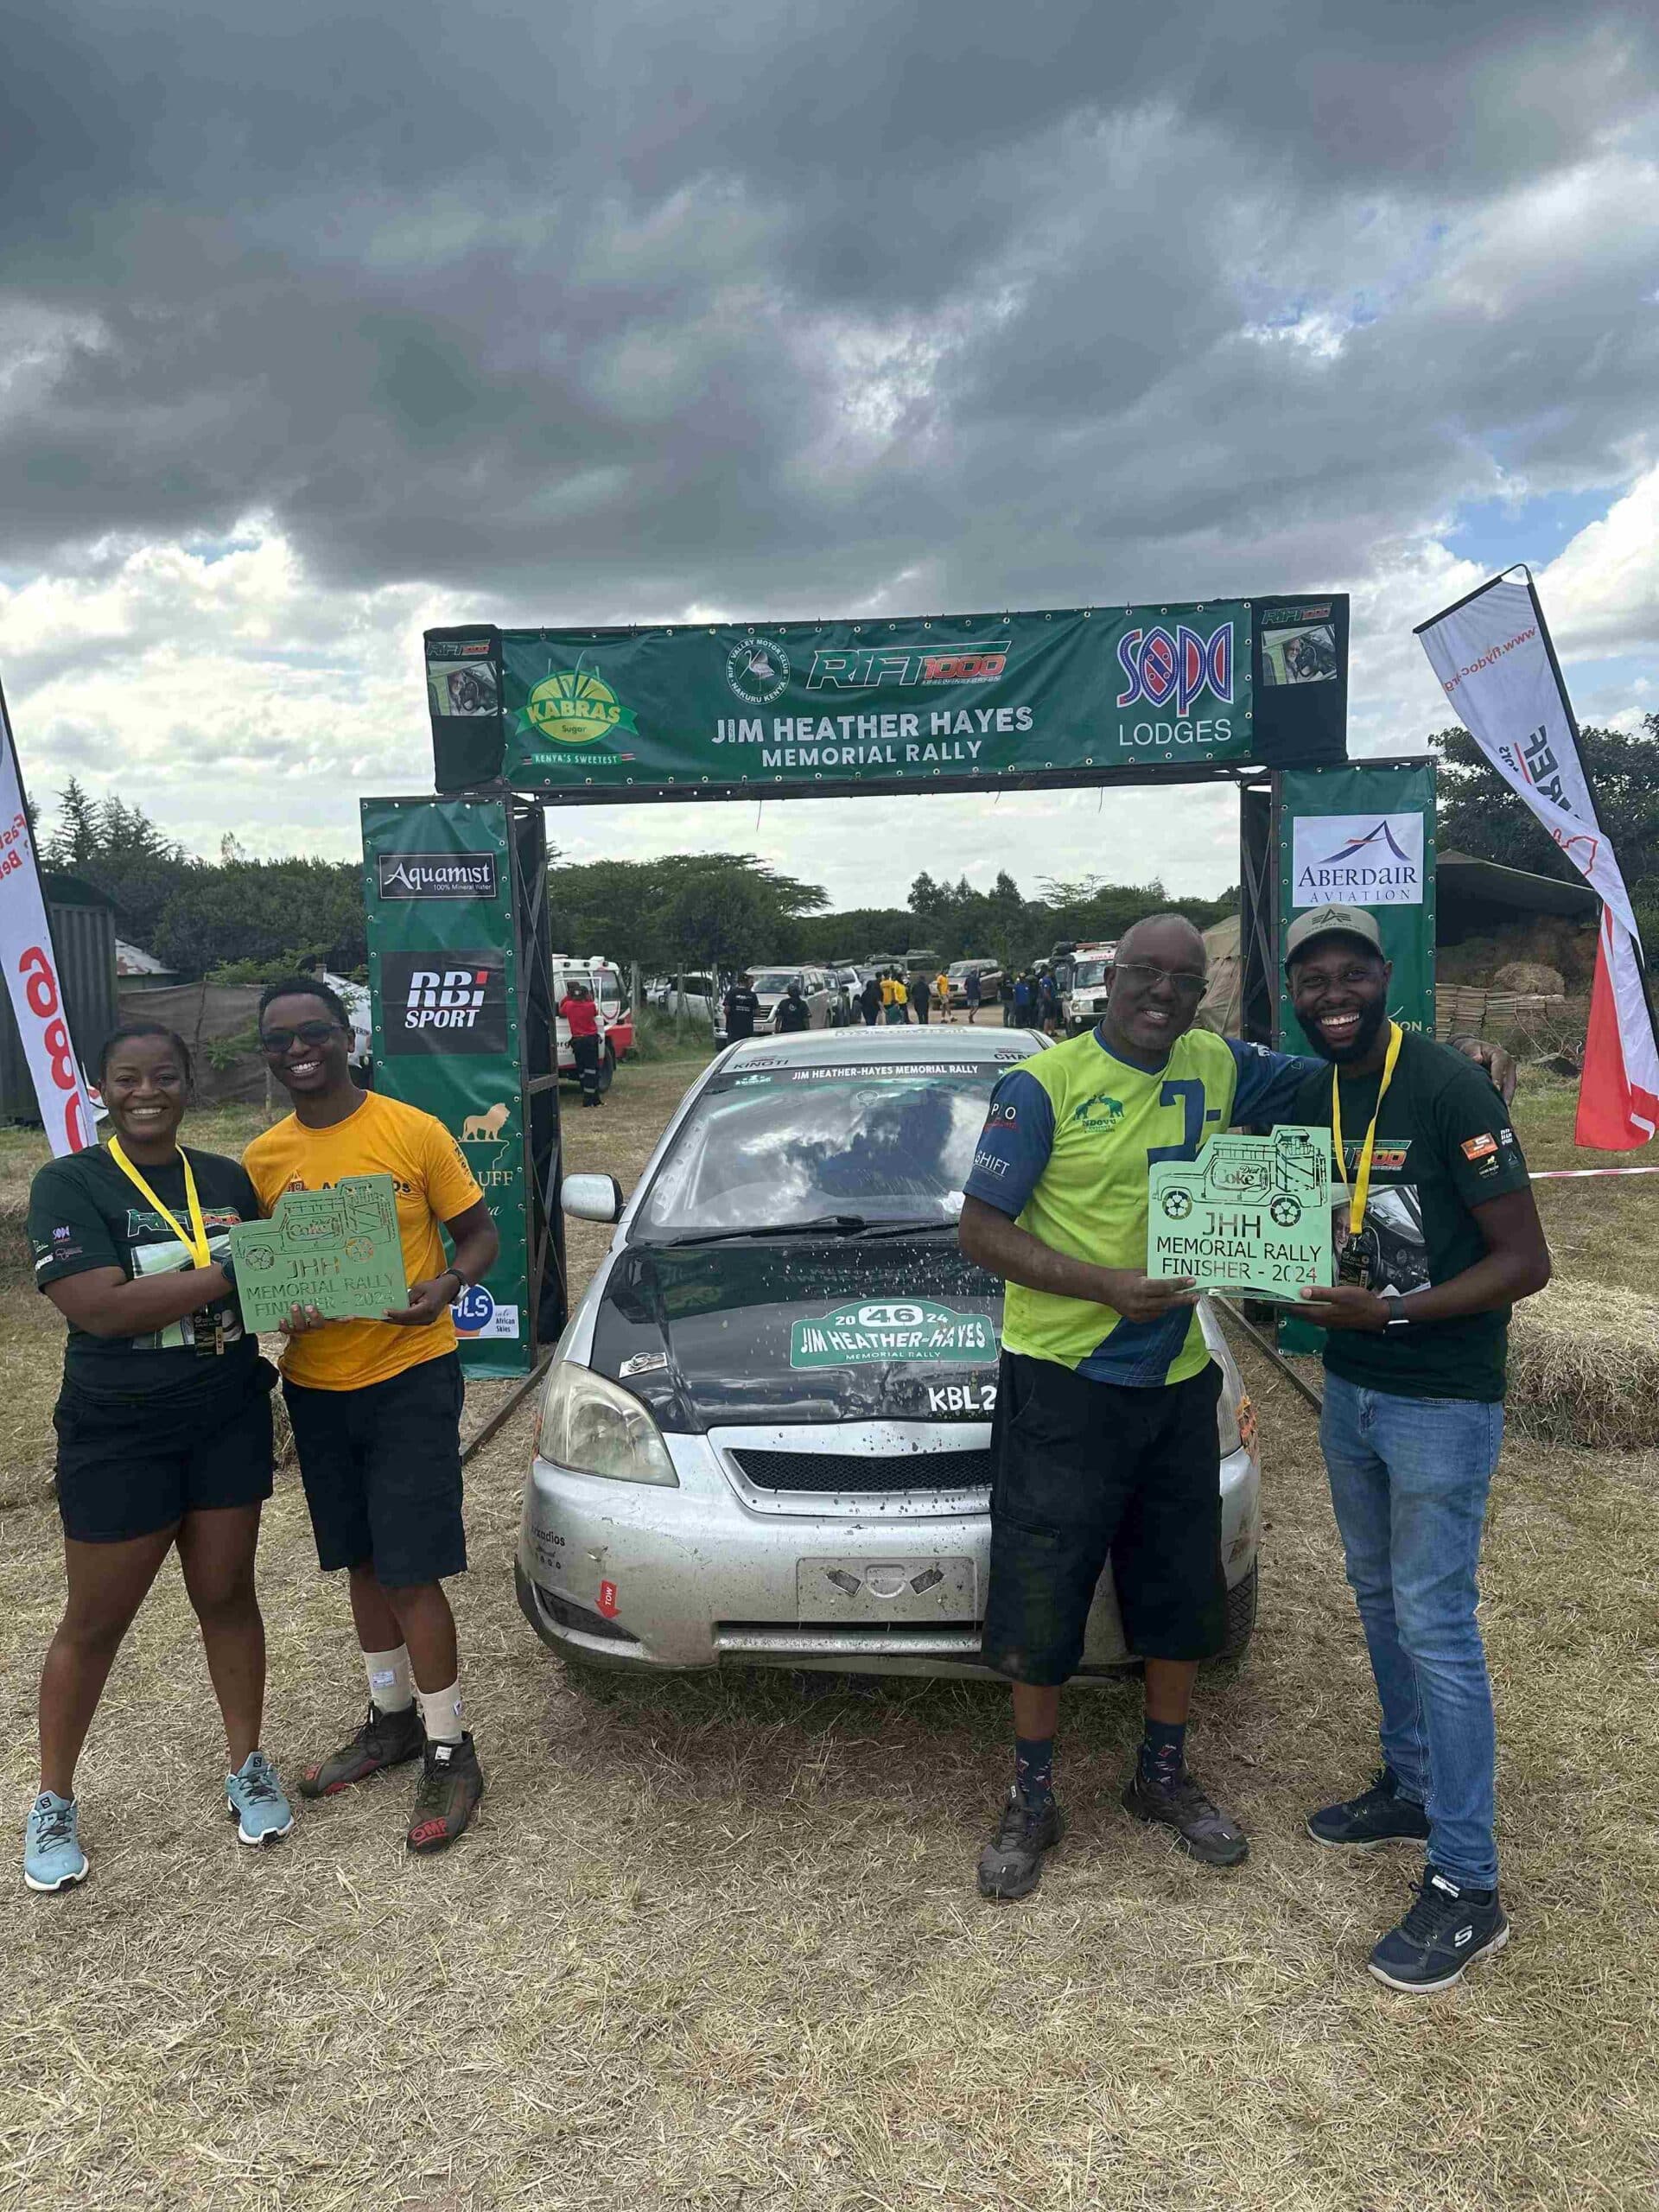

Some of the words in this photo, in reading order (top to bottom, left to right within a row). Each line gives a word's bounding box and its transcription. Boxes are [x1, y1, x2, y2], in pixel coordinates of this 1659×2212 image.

[731, 639, 754, 658] VALLEY
[756, 639, 781, 654] MOTOR
[779, 654, 789, 674] CLUB
[924, 655, 1007, 679] 1000
[732, 682, 762, 702] NAKURU
[764, 682, 786, 702] KENYA
[526, 700, 620, 724] KABRAS
[711, 718, 764, 743] JIM
[777, 714, 919, 741] HEATHER
[931, 706, 1033, 735] HAYES
[1120, 719, 1231, 746] LODGES
[575, 755, 617, 764] SWEETEST
[762, 745, 897, 767] MEMORIAL
[906, 741, 982, 761] RALLY
[384, 862, 491, 890] Aquamist
[1310, 888, 1411, 903] AVIATION
[404, 1009, 480, 1028] SPORT
[734, 1059, 789, 1069] KINOTI
[792, 1071, 810, 1080] JIM
[812, 1065, 893, 1078] HEATHER-HAYES
[895, 1065, 947, 1075] MEMORIAL
[950, 1065, 978, 1074] RALLY
[477, 1171, 513, 1186] UFF
[1214, 1169, 1255, 1185] Coke
[1203, 1211, 1261, 1238] JHH
[1157, 1236, 1258, 1258] MEMORIAL
[1264, 1243, 1322, 1262] RALLY
[287, 1256, 340, 1280] JHH
[1162, 1257, 1251, 1279] FINISHER
[246, 1280, 340, 1300] MEMORIAL
[344, 1273, 395, 1292] RALLY
[835, 1316, 855, 1325] 20
[867, 1308, 916, 1323] 46
[926, 1313, 949, 1324] 24
[800, 1327, 828, 1353] JIM
[830, 1322, 986, 1351] HEATHER-HAYES
[846, 1351, 904, 1360] MEMORIAL
